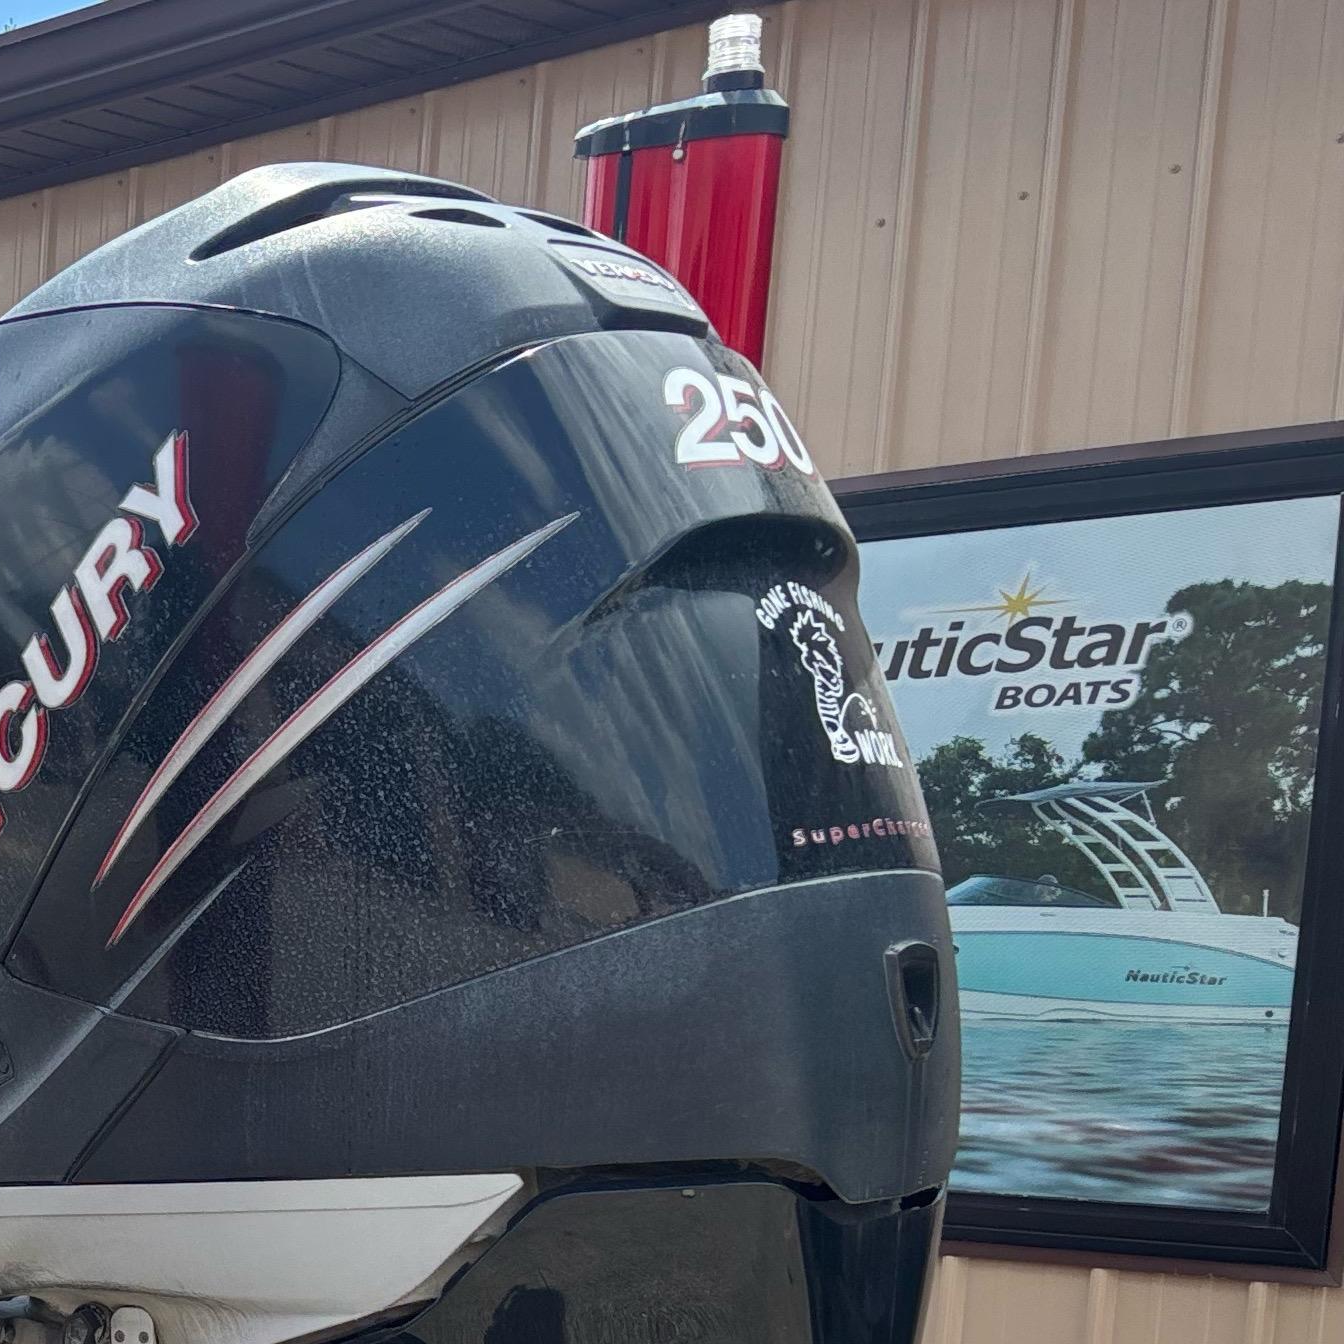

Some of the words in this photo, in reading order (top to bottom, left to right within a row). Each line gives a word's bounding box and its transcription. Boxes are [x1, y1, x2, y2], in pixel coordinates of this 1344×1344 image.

[663, 367, 817, 478] 250
[755, 584, 792, 630] GONE
[786, 581, 846, 632] FISHING
[872, 615, 1169, 682] uticStar
[993, 678, 1135, 710] BOATS
[1125, 969, 1228, 986] NauticStar
